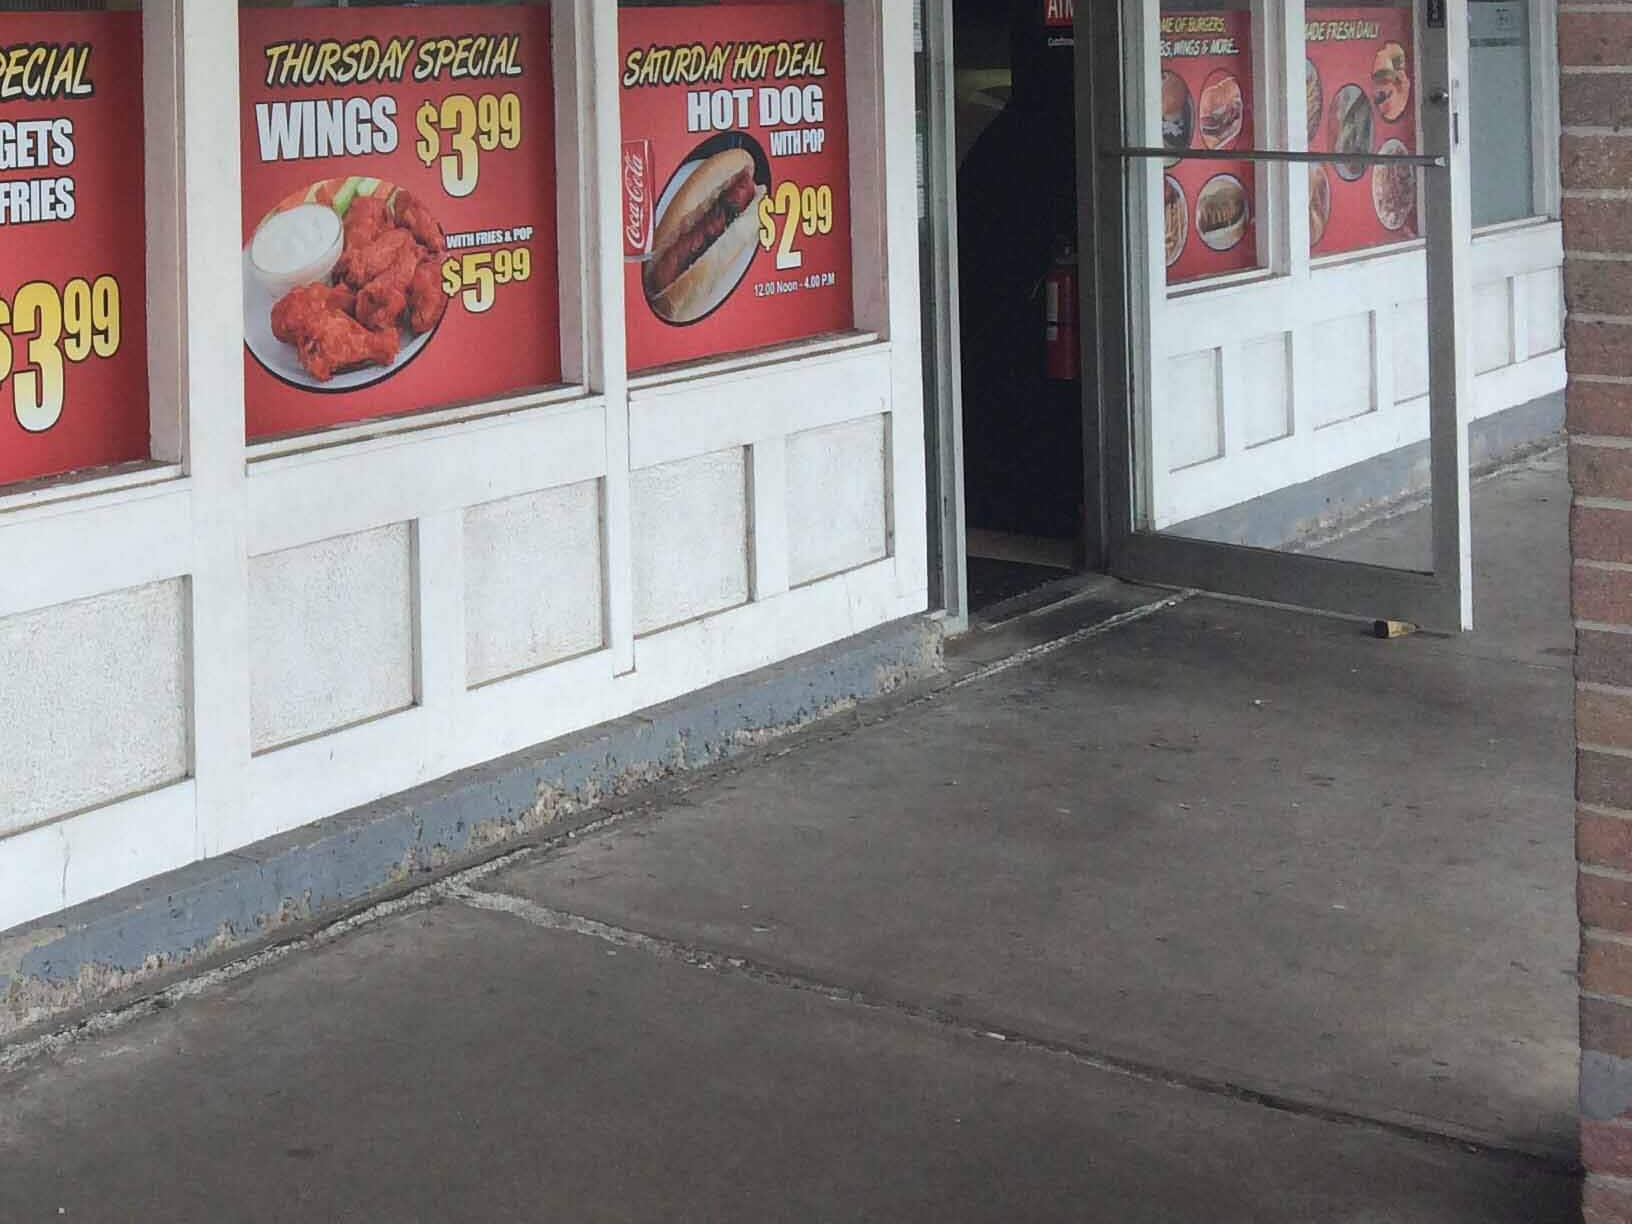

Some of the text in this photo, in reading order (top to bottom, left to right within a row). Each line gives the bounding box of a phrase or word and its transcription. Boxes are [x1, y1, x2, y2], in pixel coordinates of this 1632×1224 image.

[1327, 21, 1355, 40] FRESH
[264, 36, 523, 87] THURSDAY SPECIAL
[1173, 40, 1201, 56] WINGS
[623, 40, 826, 87] SATURDAY HOT DEAL
[687, 84, 824, 132] HOT DOG
[254, 95, 400, 163] WINGS
[770, 127, 825, 157] WITH POP
[445, 226, 533, 249] WITH FRIES & POP
[776, 280, 798, 294] Noon
